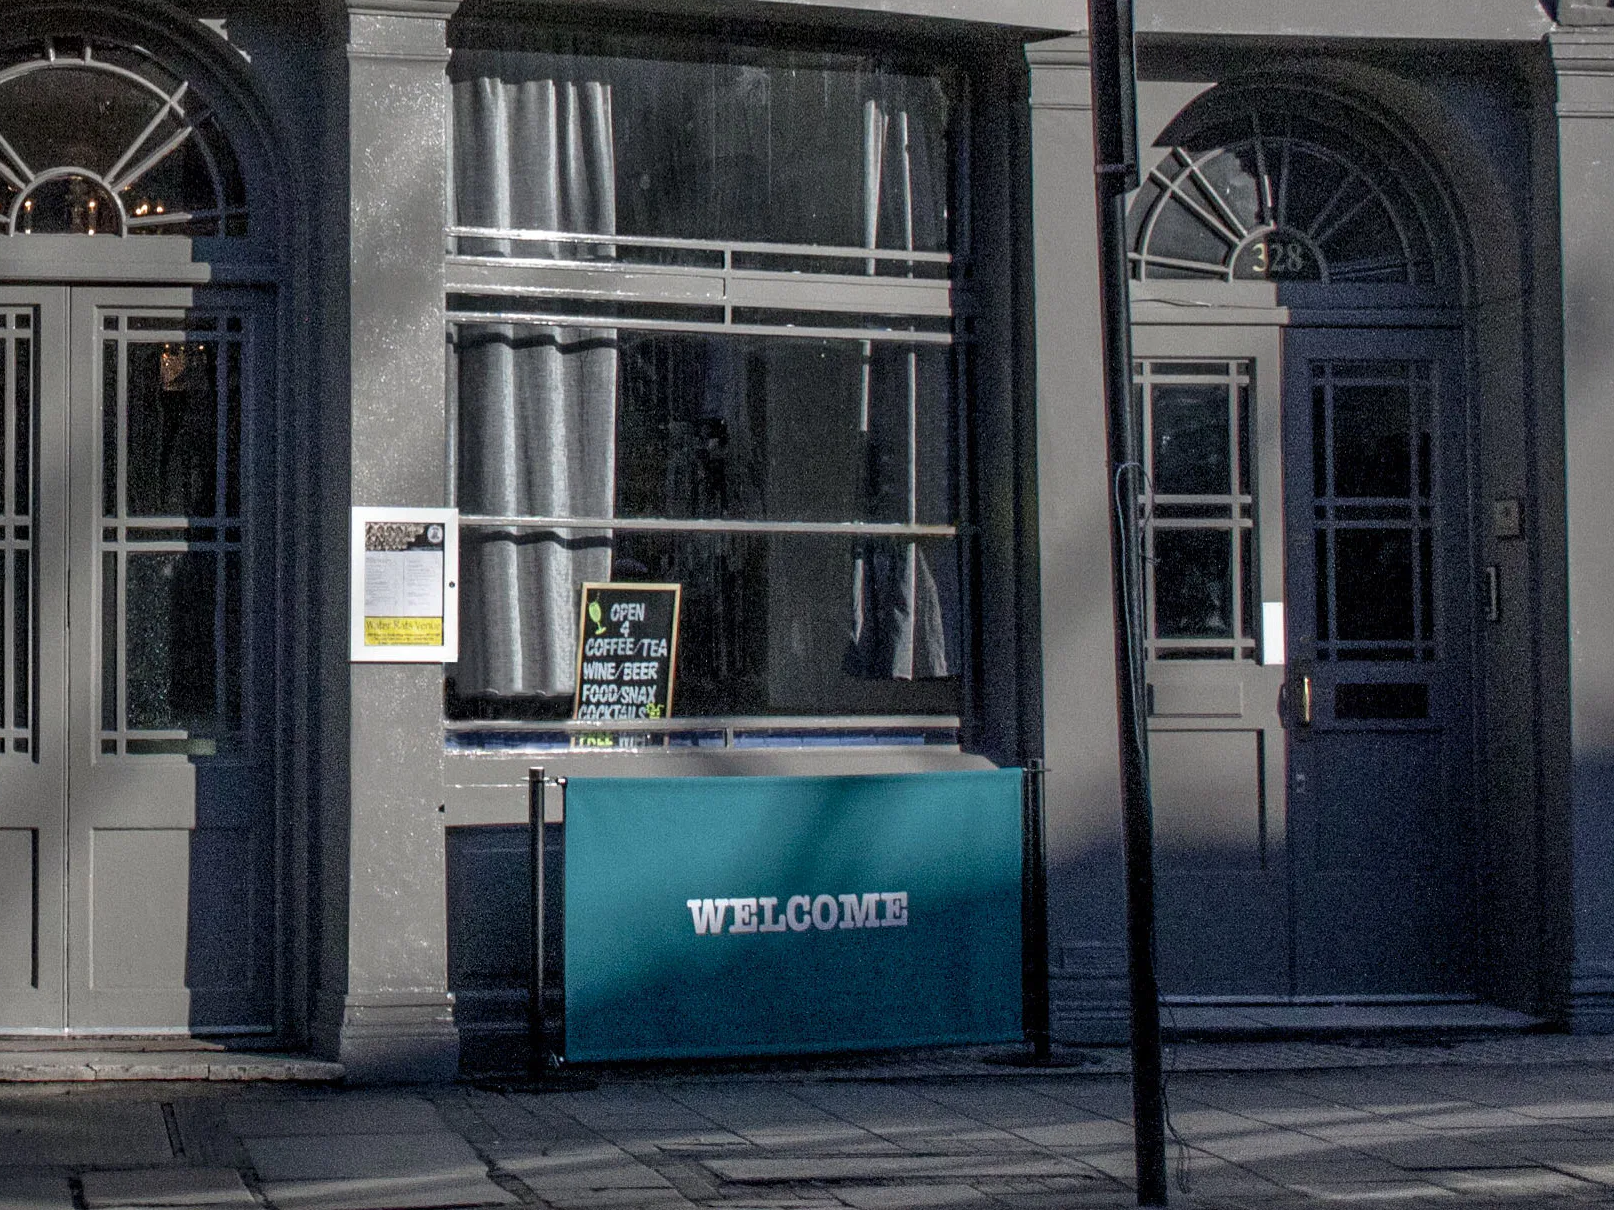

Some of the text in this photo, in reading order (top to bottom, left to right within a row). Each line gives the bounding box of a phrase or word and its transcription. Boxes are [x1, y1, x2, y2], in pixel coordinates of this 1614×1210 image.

[1252, 243, 1303, 272] 328
[610, 603, 645, 621] OPEN
[620, 620, 630, 638] 4
[578, 704, 647, 719] COCKTAILS
[687, 891, 908, 935] WELCOME
